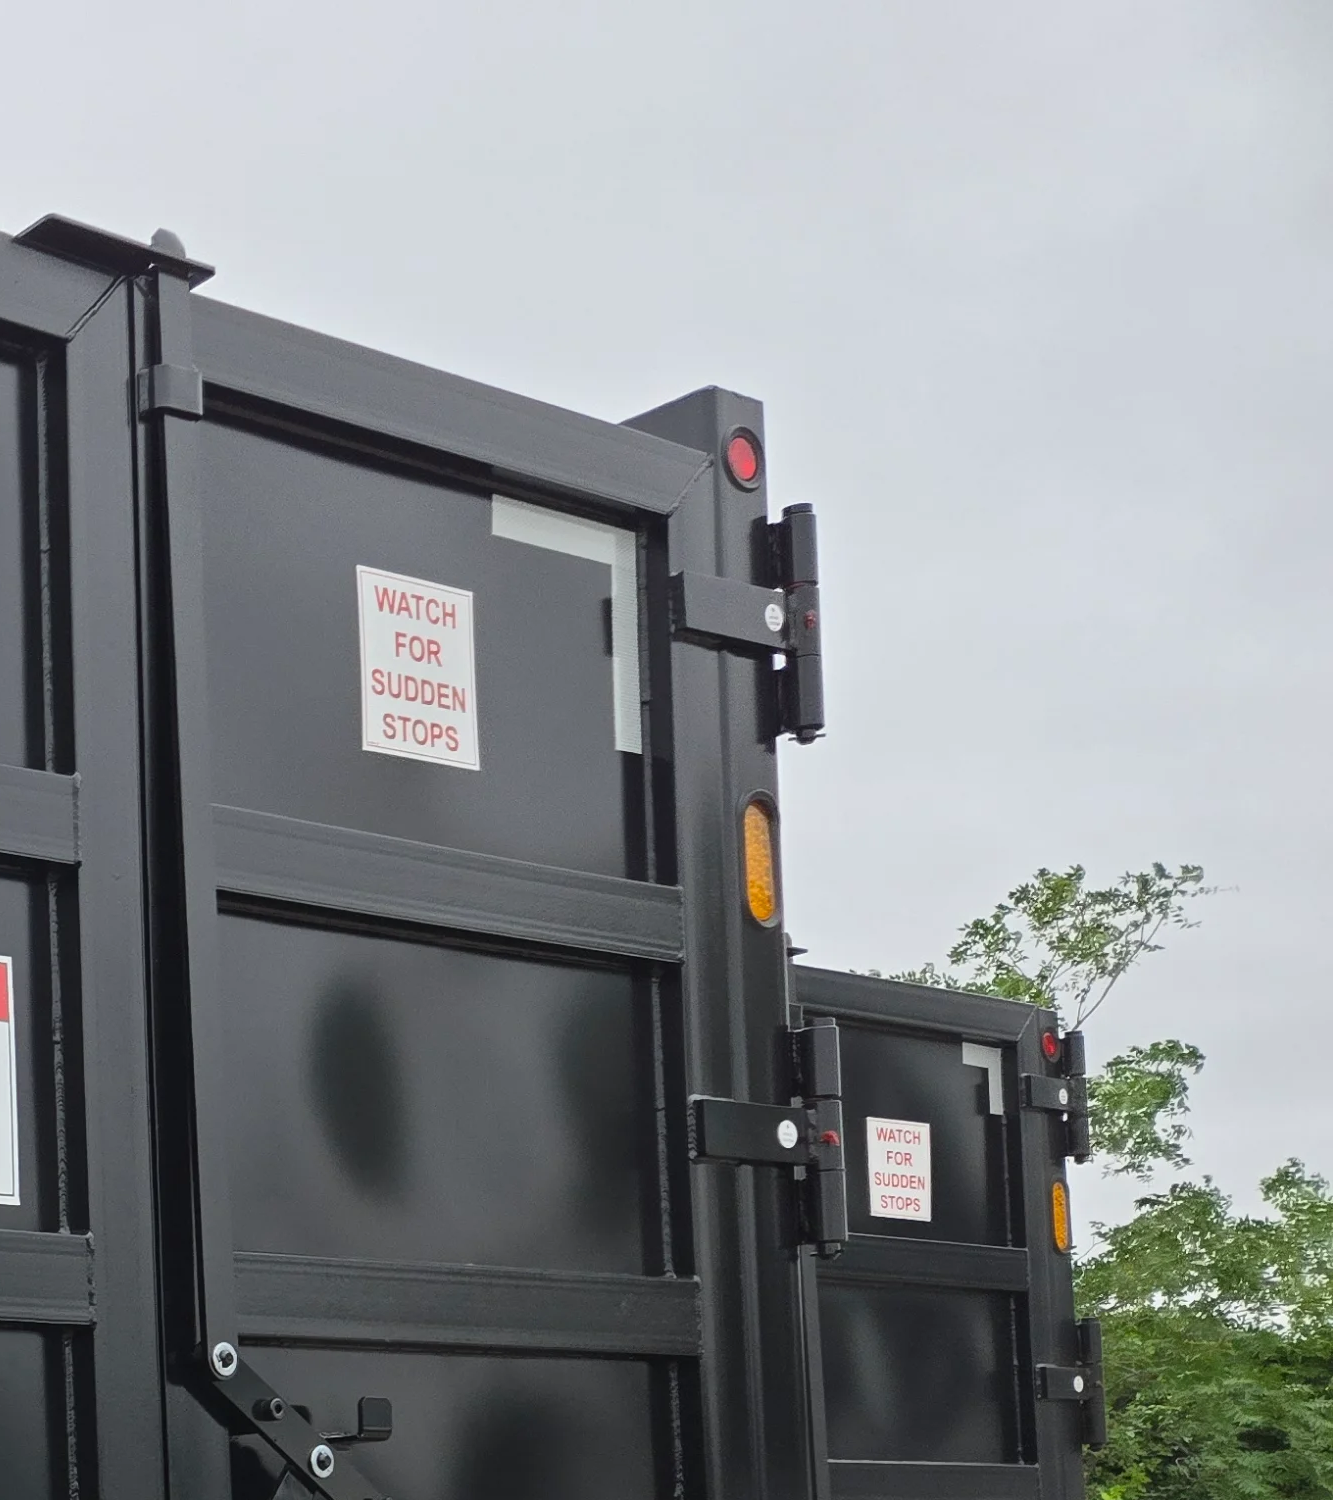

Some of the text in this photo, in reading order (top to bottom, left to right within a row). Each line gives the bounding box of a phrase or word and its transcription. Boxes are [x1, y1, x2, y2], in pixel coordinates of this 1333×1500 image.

[374, 585, 456, 629] WATCH
[395, 632, 442, 667] FOR
[372, 669, 466, 713] SUDDEN
[383, 713, 458, 751] STOPS
[876, 1127, 921, 1145] WATCH
[887, 1151, 912, 1166] FOR
[874, 1172, 925, 1190] SUDDEN
[881, 1195, 920, 1212] STOPS
